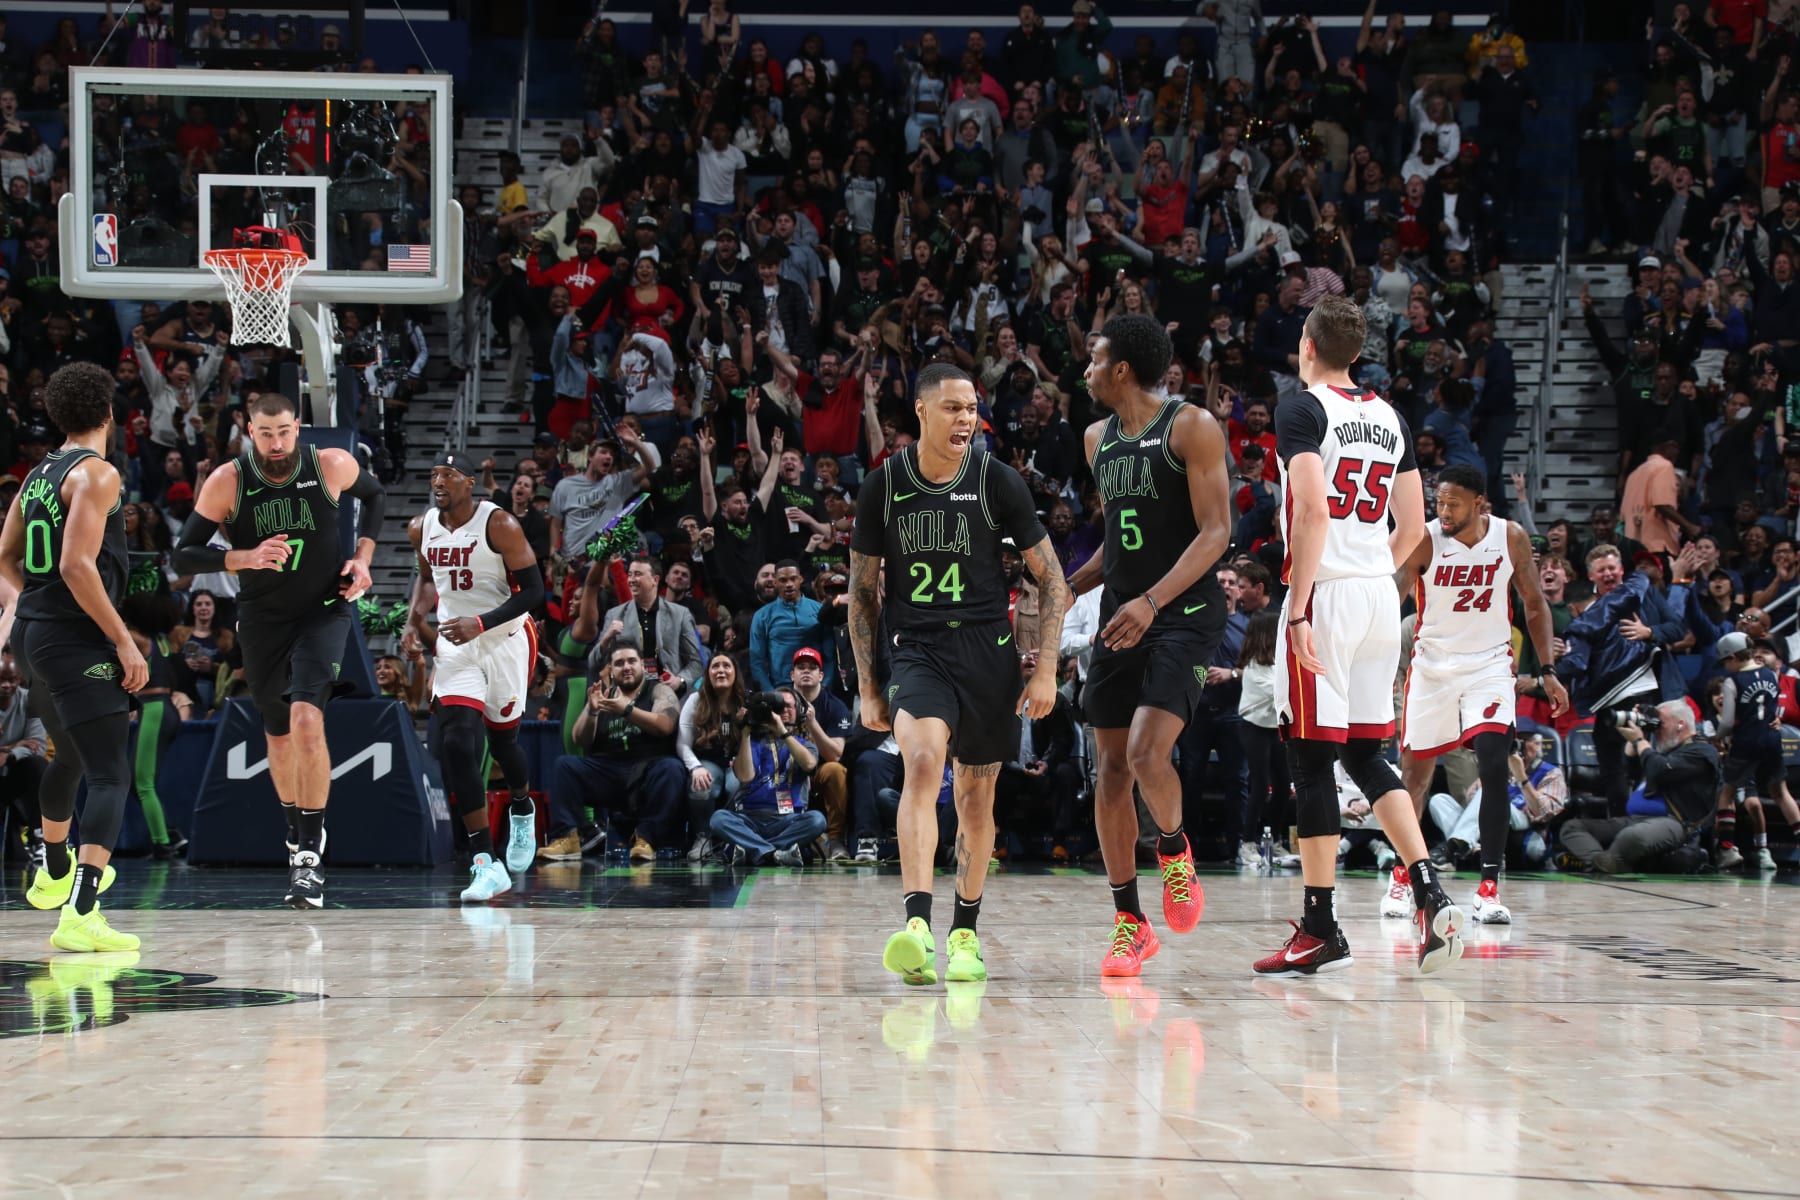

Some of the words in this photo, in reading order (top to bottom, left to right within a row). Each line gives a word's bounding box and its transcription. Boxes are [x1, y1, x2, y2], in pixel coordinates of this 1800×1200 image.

[1140, 438, 1161, 449] ibotta
[1333, 421, 1397, 455] ROBINSON
[1099, 455, 1159, 504] NOLA
[1327, 457, 1394, 523] 55
[950, 493, 978, 502] ibotta
[253, 498, 316, 538] NOLA
[897, 510, 972, 556] NOLA
[1120, 508, 1144, 551] 5
[25, 519, 53, 574] 0
[428, 541, 478, 567] HEAT
[450, 569, 473, 591] 13
[910, 562, 965, 603] 24
[1434, 556, 1503, 587] HEAT
[1453, 588, 1493, 612] 24
[1755, 694, 1766, 721] 1
